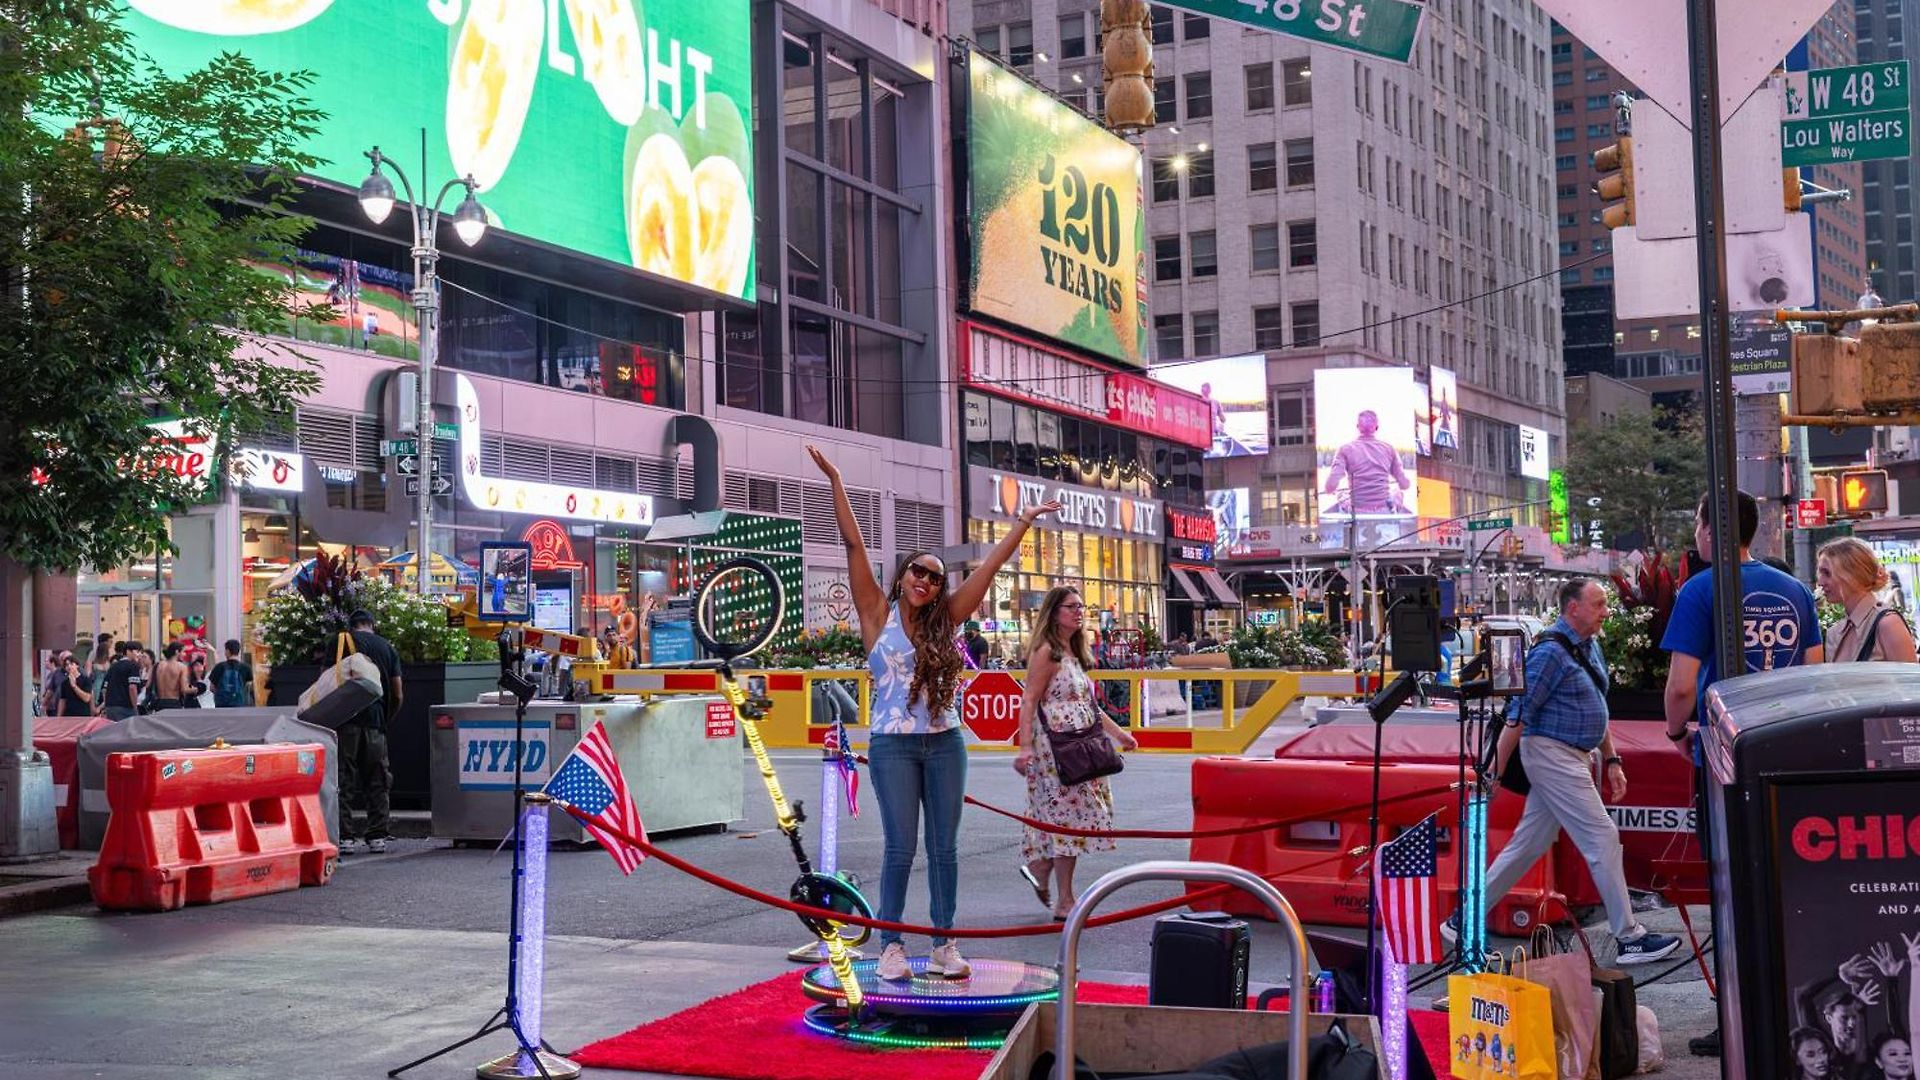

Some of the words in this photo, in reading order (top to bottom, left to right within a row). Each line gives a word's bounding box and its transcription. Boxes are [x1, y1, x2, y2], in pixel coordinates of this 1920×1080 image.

[1314, 0, 1366, 37] St
[1812, 76, 1831, 110] W
[1842, 71, 1875, 107] 48
[1883, 67, 1901, 88] St
[1783, 125, 1820, 148] Lou
[1828, 119, 1903, 143] Walters
[1831, 147, 1854, 160] Way
[1038, 153, 1121, 268] 120
[1040, 244, 1122, 314] YEARS
[1747, 348, 1778, 360] Square
[1764, 360, 1787, 369] Plaza
[1056, 488, 1106, 528] GIFTS
[1133, 503, 1157, 536] NY
[1173, 512, 1186, 538] THE
[1249, 530, 1271, 541] CVS
[1743, 619, 1798, 647] 360
[966, 694, 1021, 720] STOP
[463, 740, 546, 773] NYPD
[1791, 814, 1920, 862] CHI
[1878, 904, 1908, 915] AND
[1625, 945, 1643, 953] HOKA
